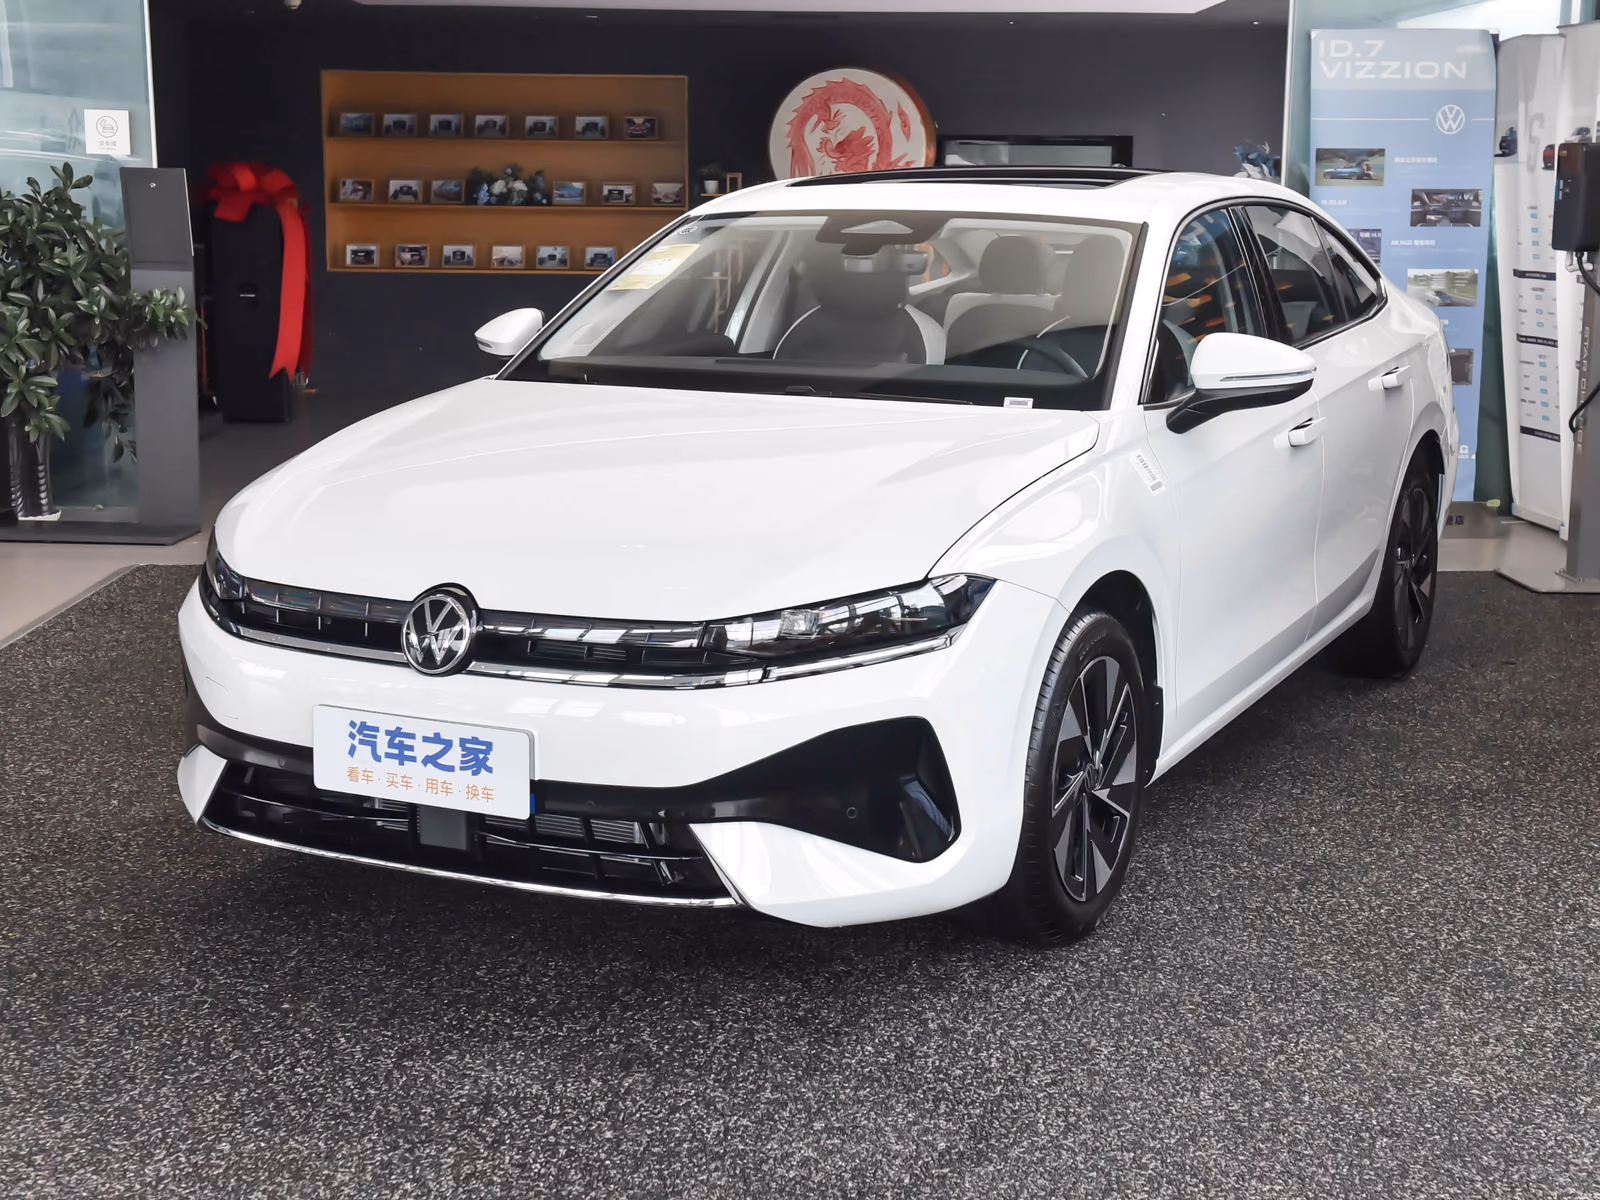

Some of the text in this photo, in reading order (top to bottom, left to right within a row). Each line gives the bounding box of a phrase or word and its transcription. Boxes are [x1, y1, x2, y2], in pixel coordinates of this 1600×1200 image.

[1319, 39, 1385, 57] ID.7
[1319, 61, 1467, 79] VIZZION
[1582, 326, 1590, 372] STAR
[347, 720, 494, 777] 汽车之家
[347, 766, 495, 803] 看车 买车 用车 换车
